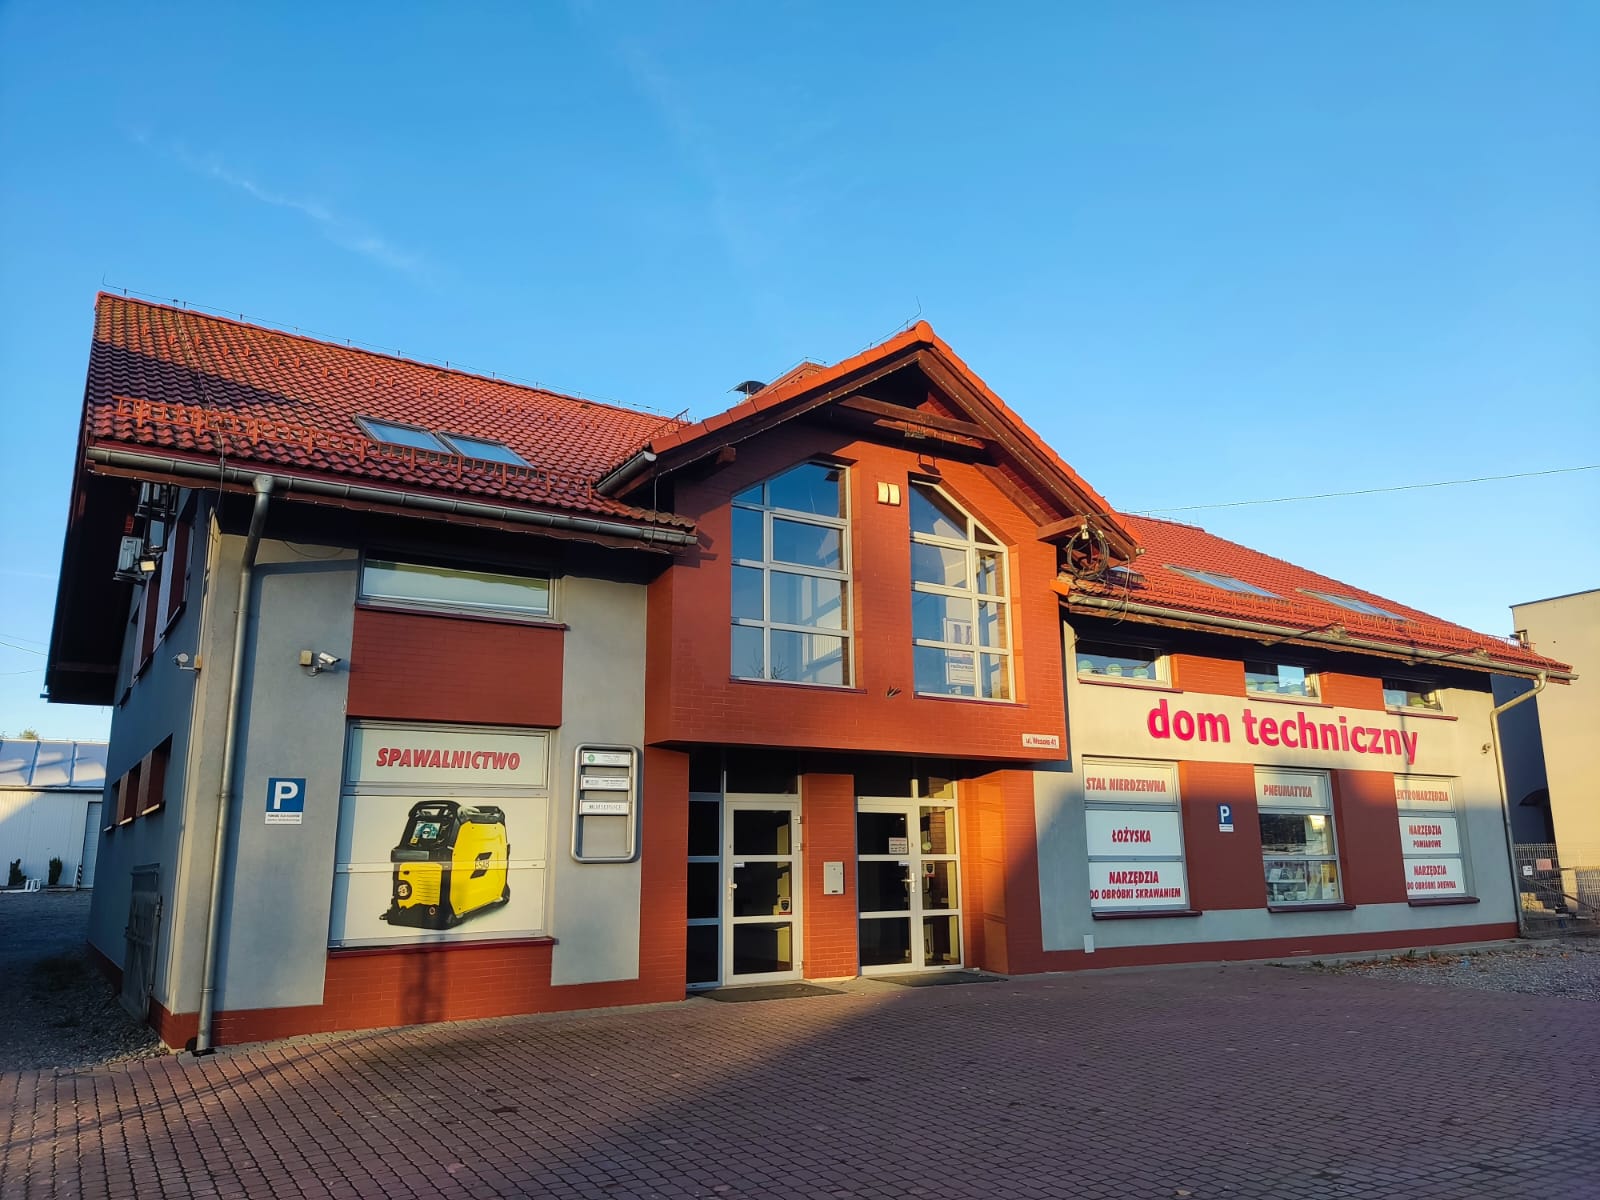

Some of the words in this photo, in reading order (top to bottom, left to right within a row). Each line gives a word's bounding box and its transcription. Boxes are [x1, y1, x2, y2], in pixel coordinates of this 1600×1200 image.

[1147, 698, 1231, 743] dom
[1242, 708, 1418, 765] techniczny
[376, 747, 520, 770] SPAWALNICTWO
[1086, 777, 1106, 791] STAL
[1109, 778, 1166, 792] NIERDZEWNA
[1263, 784, 1312, 798] PNEUMATYKA
[273, 781, 299, 810] P
[1220, 805, 1230, 823] P
[1112, 826, 1151, 843] ŁOŻYSKA
[1109, 870, 1159, 886] NARZĘDZIA
[1414, 864, 1447, 878] NARZĘDZIA
[1089, 889, 1099, 899] DO
[1101, 886, 1133, 899] OBRÓBKI
[1135, 887, 1181, 899] SKRAWANIEM
